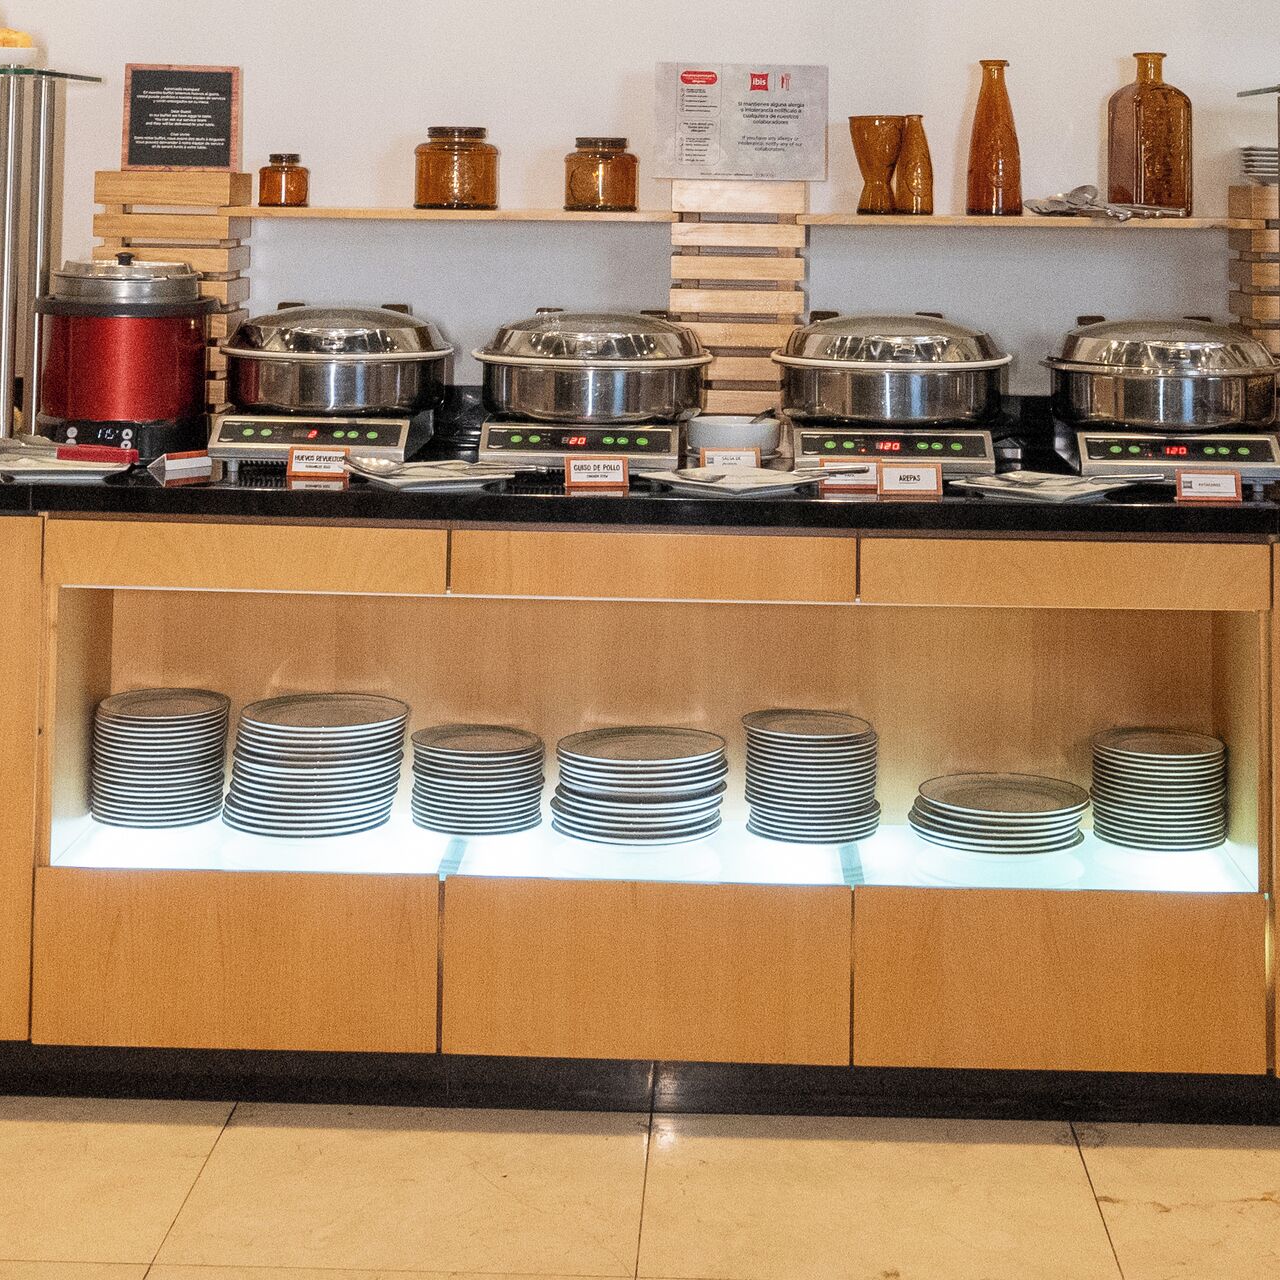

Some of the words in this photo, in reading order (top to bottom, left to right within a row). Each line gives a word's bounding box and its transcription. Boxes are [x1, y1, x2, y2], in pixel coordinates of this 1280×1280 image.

[752, 77, 767, 86] ibis
[879, 441, 901, 451] 120
[1165, 446, 1187, 455] 120
[899, 474, 921, 482] AREPAS
